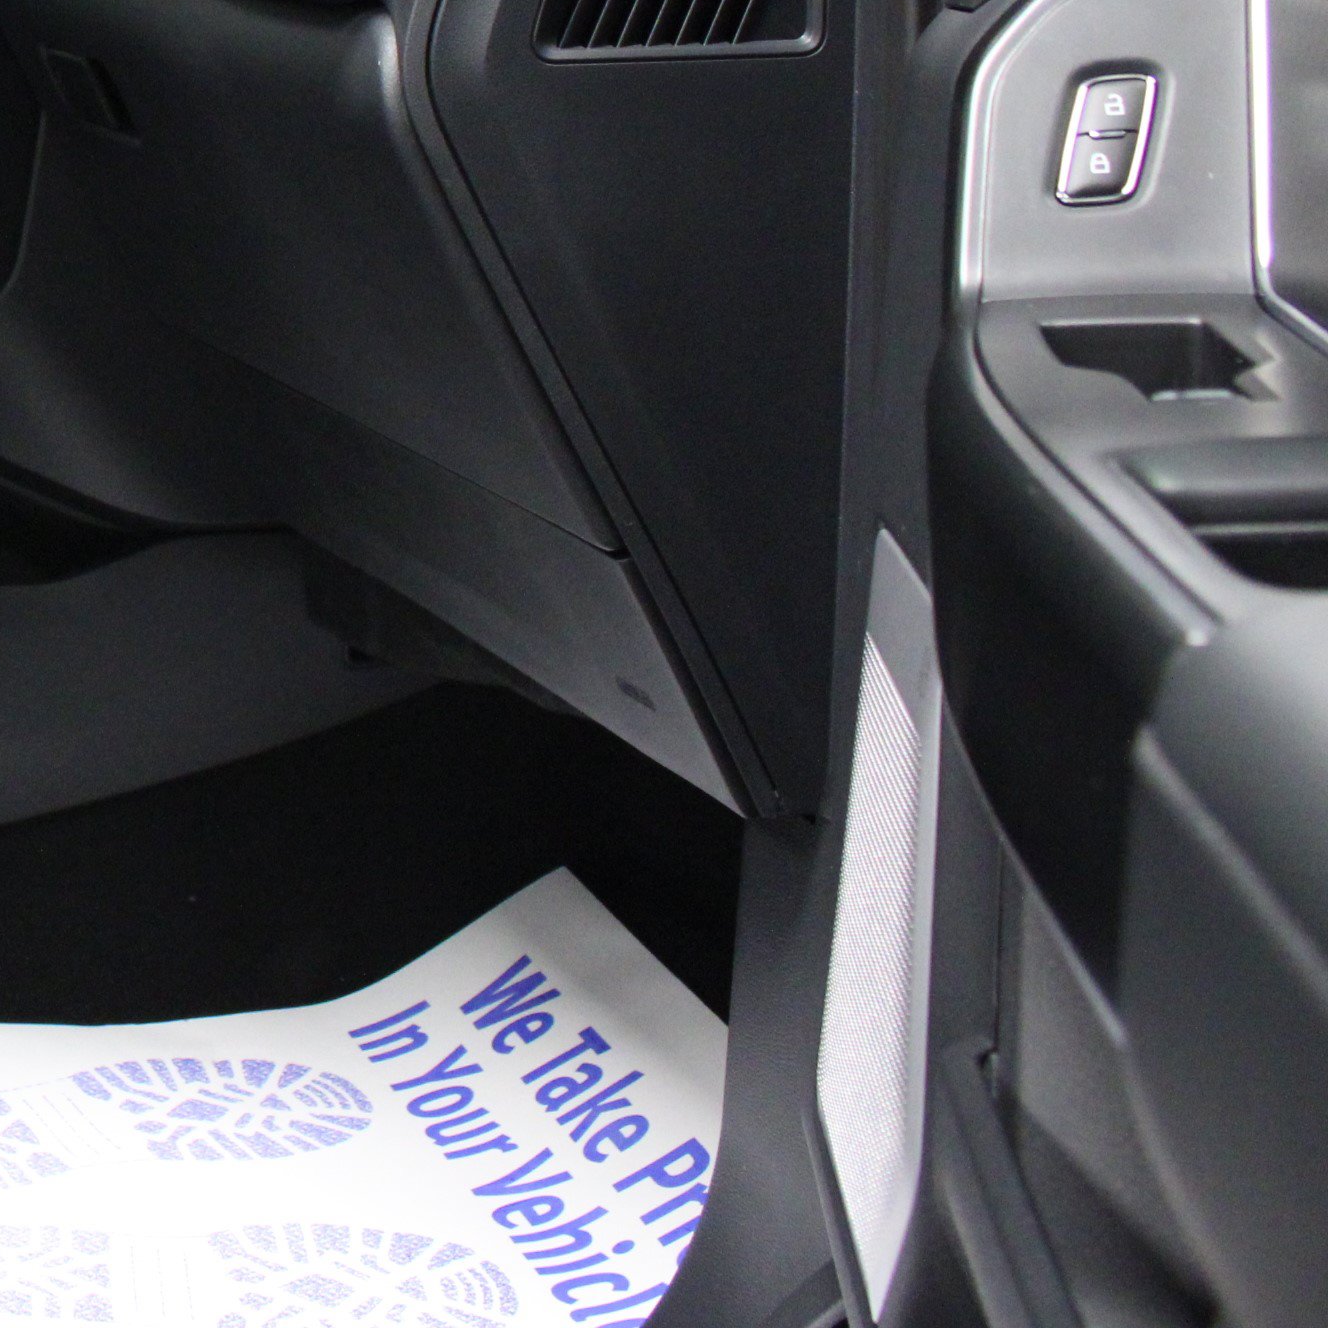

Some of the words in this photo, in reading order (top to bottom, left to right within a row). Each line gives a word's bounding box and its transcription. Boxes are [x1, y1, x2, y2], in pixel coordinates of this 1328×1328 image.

[348, 1000, 432, 1063] In
[389, 1045, 519, 1160] Your
[459, 954, 561, 1054] We
[521, 1026, 651, 1164] Take
[612, 1136, 711, 1267] Pri
[471, 1147, 670, 1328] Vehicl
